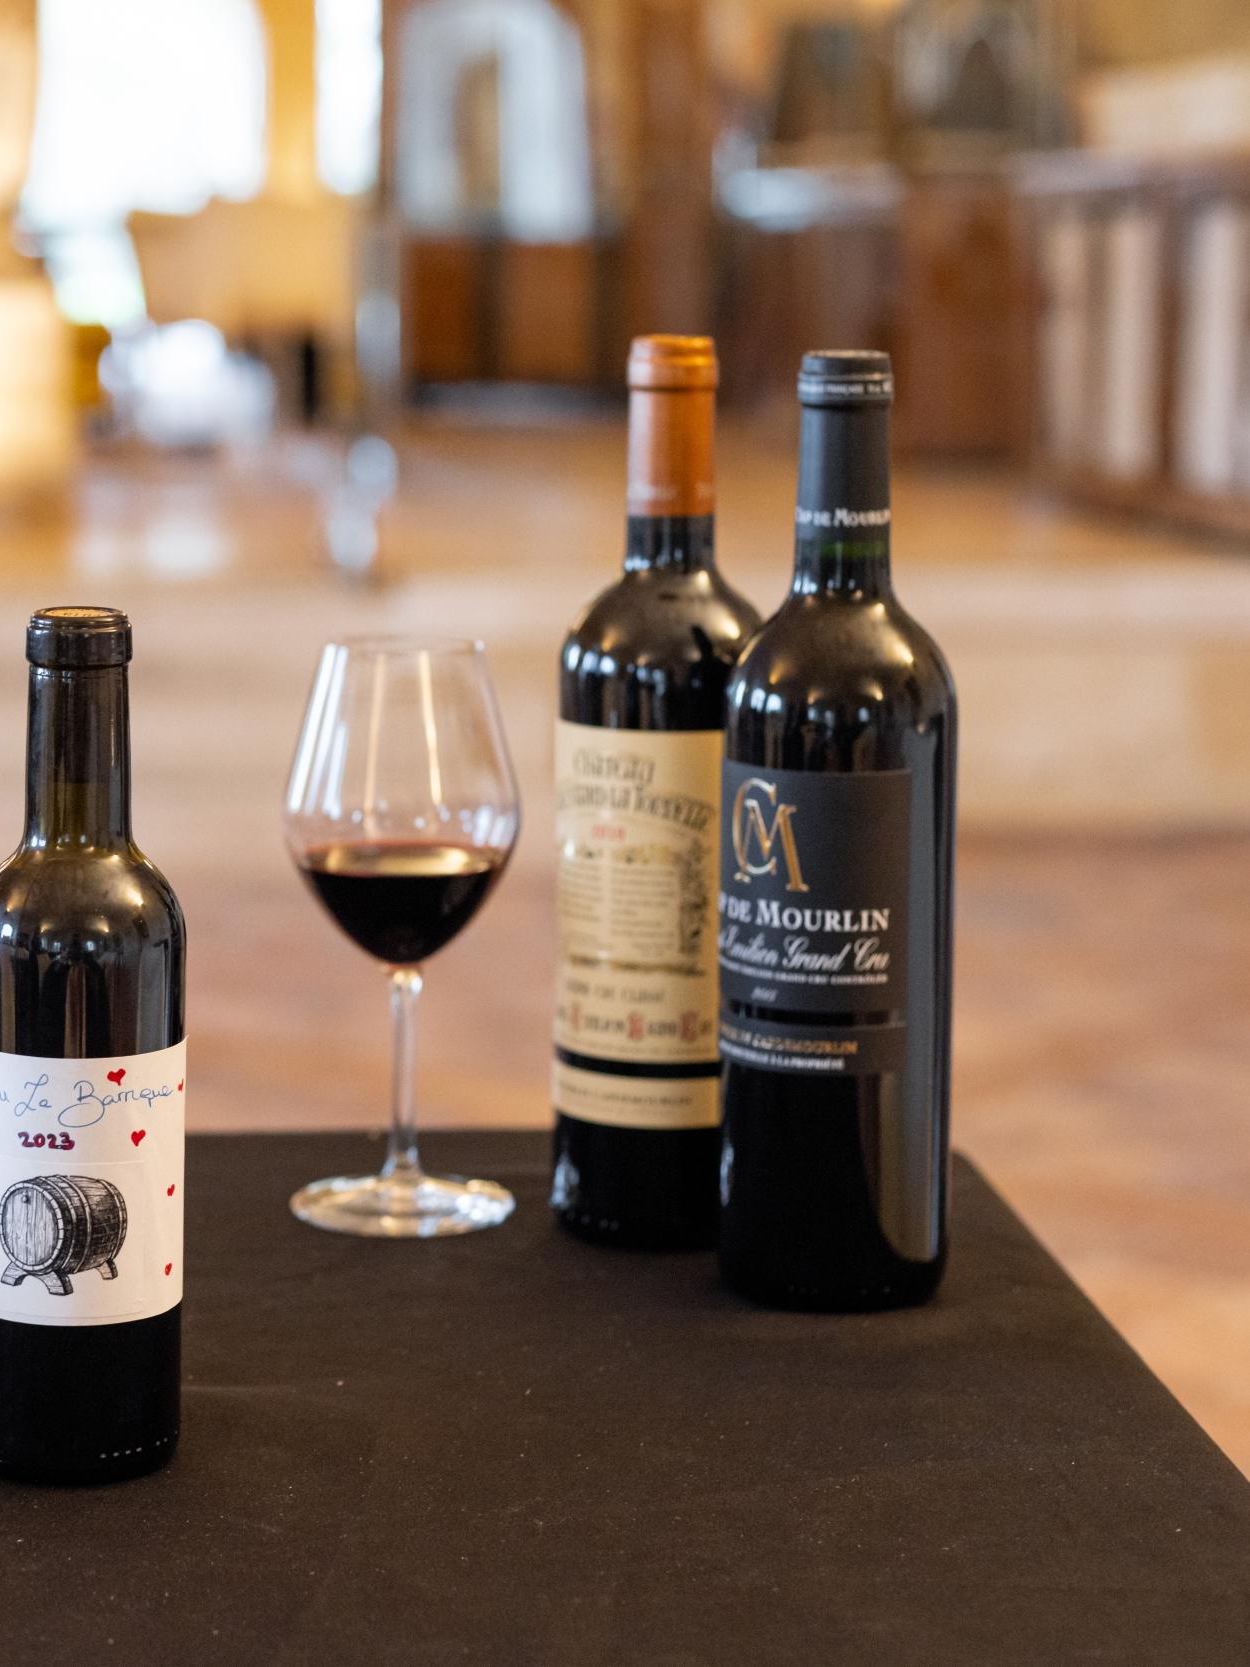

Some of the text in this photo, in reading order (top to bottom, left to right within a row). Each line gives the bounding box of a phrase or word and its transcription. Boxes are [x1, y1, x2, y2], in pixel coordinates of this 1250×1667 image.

[727, 896, 751, 923] DE
[755, 899, 890, 932] MOURLIN
[782, 935, 851, 971] Grand
[853, 937, 890, 971] Cru
[15, 1074, 52, 1116] La
[58, 1080, 173, 1127] Barrique
[18, 1132, 75, 1150] 2023
